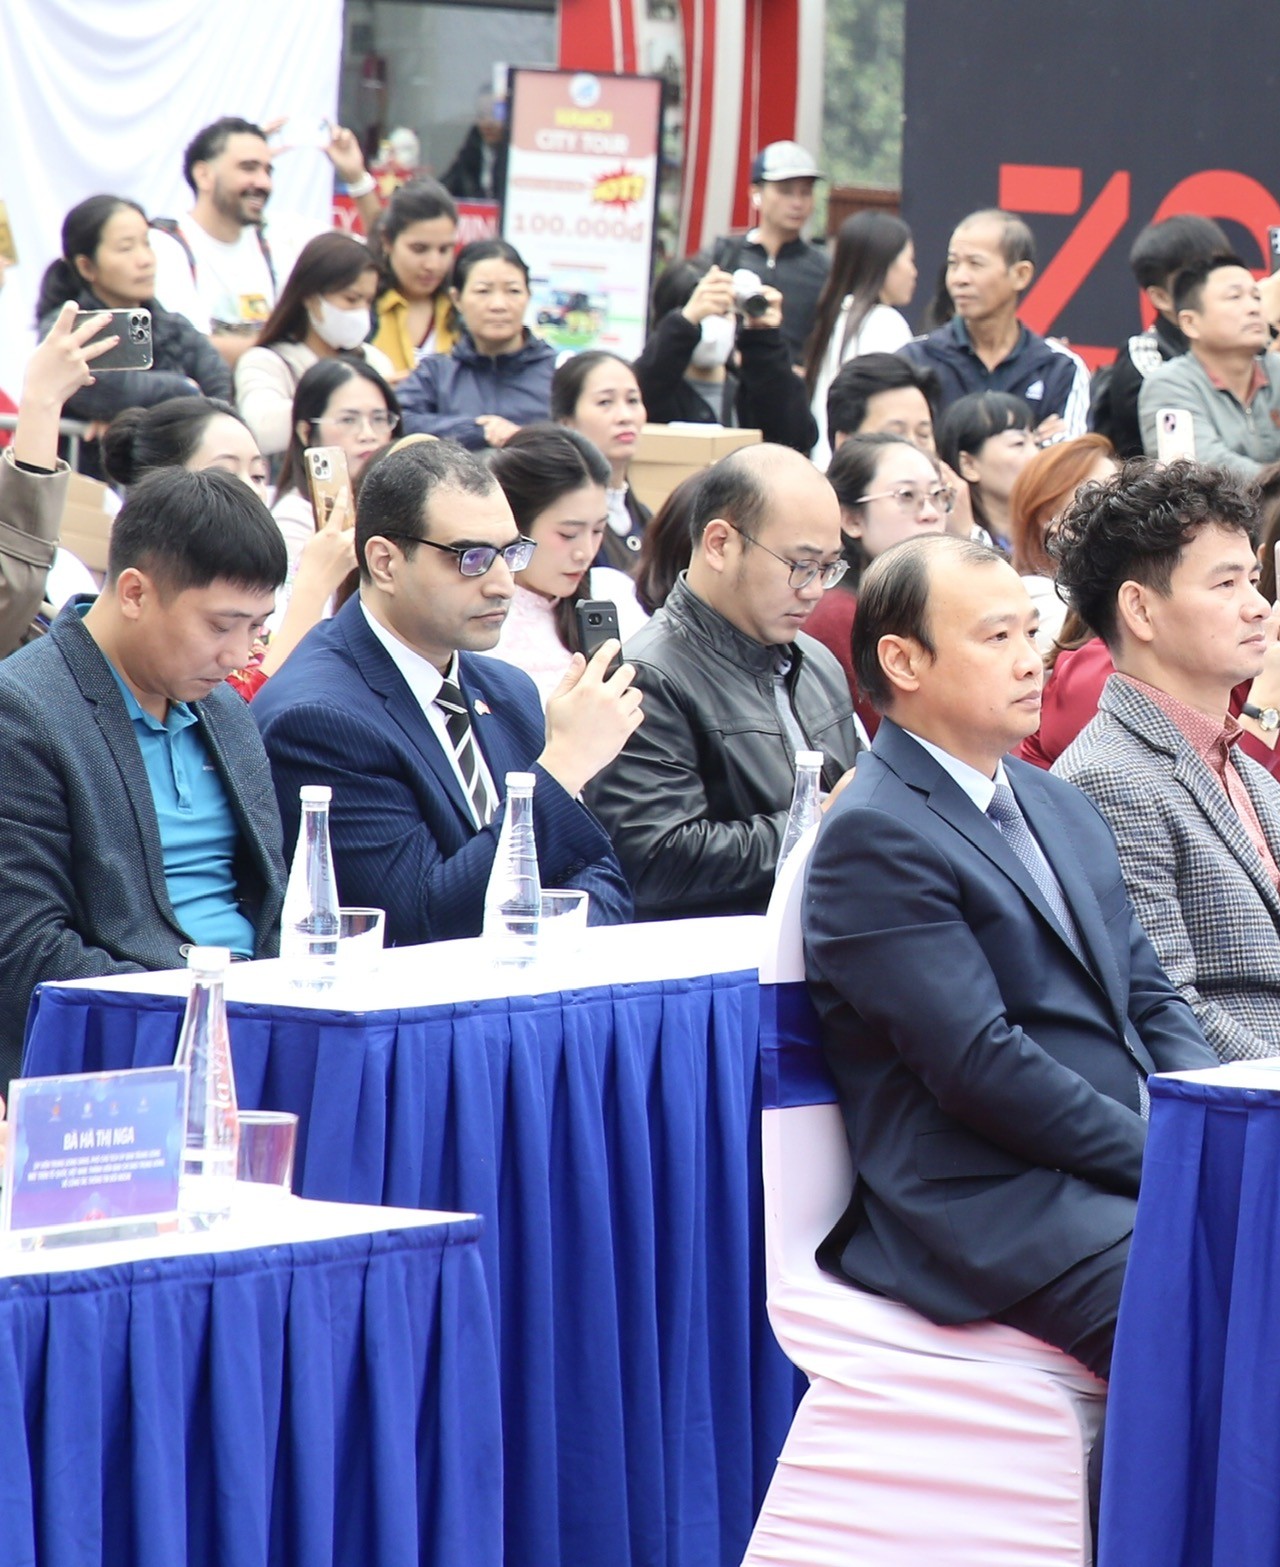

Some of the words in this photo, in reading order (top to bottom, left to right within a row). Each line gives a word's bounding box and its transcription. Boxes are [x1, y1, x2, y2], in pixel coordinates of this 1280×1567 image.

[535, 128, 577, 151] CITY
[581, 131, 629, 155] TOUR
[113, 1127, 134, 1145] NGA
